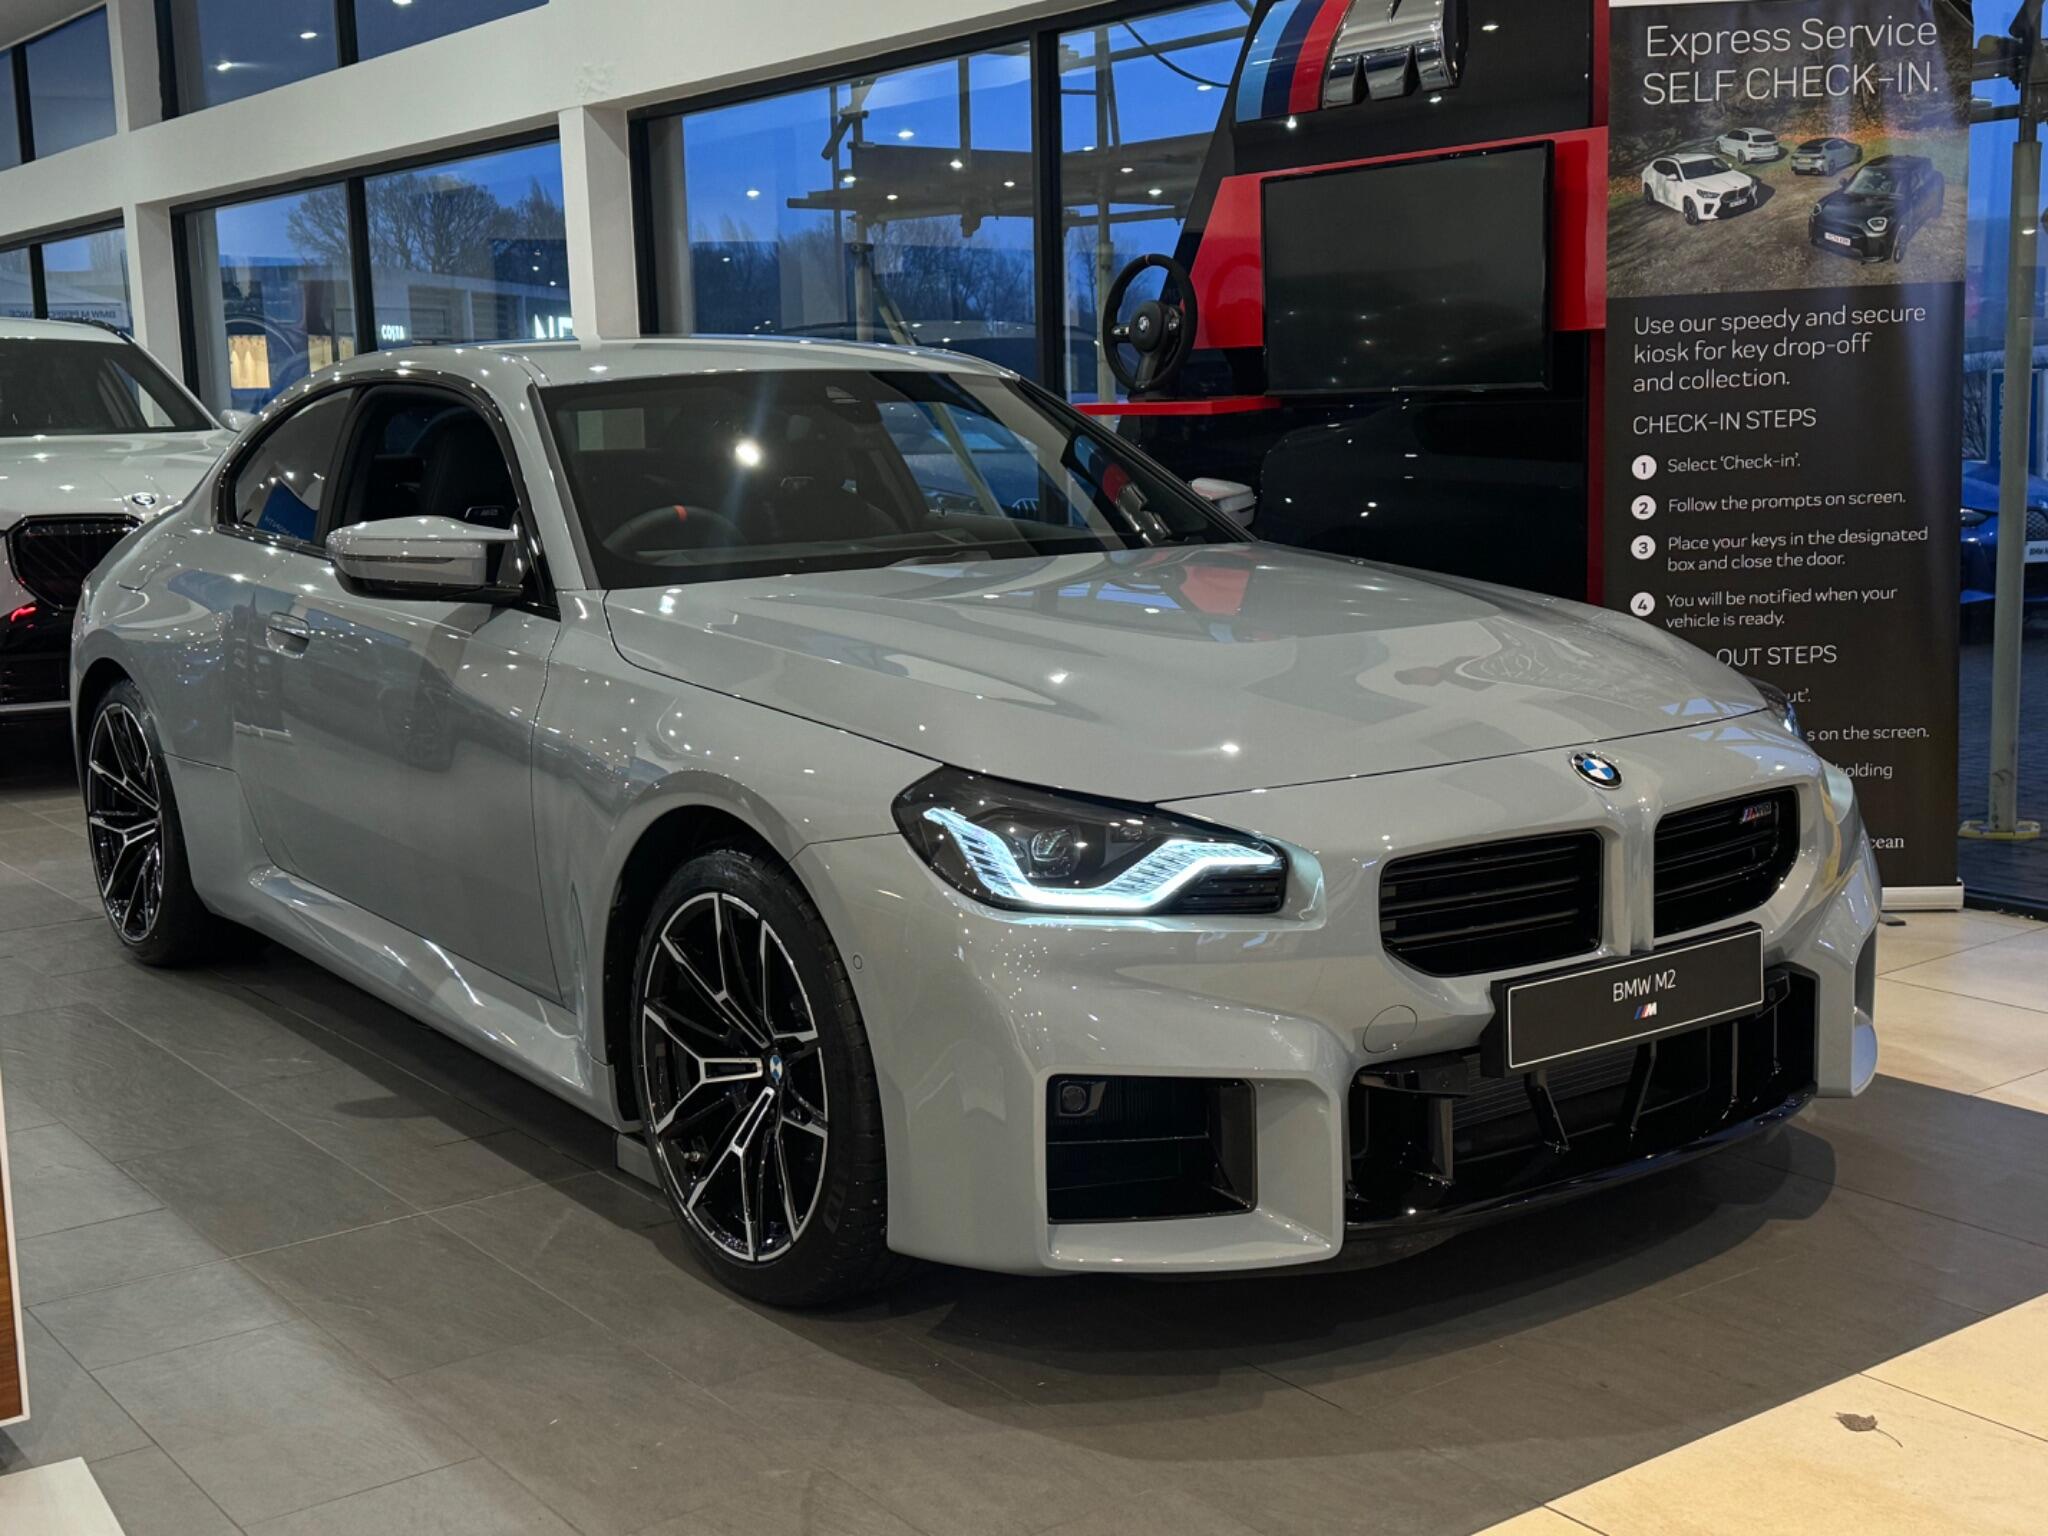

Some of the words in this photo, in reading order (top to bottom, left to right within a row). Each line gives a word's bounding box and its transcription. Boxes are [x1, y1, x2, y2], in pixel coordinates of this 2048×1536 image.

[1648, 26, 1790, 63] Express
[1801, 16, 1936, 50] Service
[1643, 68, 1737, 105] SELF
[1746, 61, 1938, 101] CHECK-IN.
[1634, 316, 1674, 336] Use
[1680, 318, 1716, 332] our
[1721, 310, 1800, 335] speedy
[1806, 305, 1846, 326] and
[1851, 305, 1926, 323] secure
[1634, 342, 1688, 363] kiosk
[1695, 340, 1726, 360] for
[1732, 339, 1768, 362] key
[1774, 333, 1872, 358] drop-off
[1634, 371, 1673, 392] and
[1679, 368, 1790, 390] collection.
[1633, 412, 1740, 434] CHECK-IN
[1746, 408, 1816, 429] STEPS
[1668, 458, 1717, 472] Select
[1669, 497, 1717, 512] Follow
[1721, 496, 1748, 510] the
[1752, 496, 1821, 511] prompts
[1825, 494, 1846, 507] on
[1849, 491, 1907, 505] screen.
[1668, 536, 1708, 550] Place
[1712, 537, 1747, 551] your
[1752, 533, 1786, 549] keys
[1791, 533, 1803, 545] in
[1808, 530, 1835, 544] the
[1838, 526, 1928, 545] designated
[1668, 557, 1695, 571] box
[1699, 555, 1727, 570] and
[1731, 554, 1772, 569] close
[1777, 552, 1803, 567] the
[1807, 551, 1845, 566] door.
[1667, 595, 1694, 607] You
[1698, 591, 1722, 606] will
[1726, 591, 1745, 605] be
[1749, 588, 1811, 604] notified
[1815, 587, 1857, 601] when
[1861, 589, 1897, 603] your
[1666, 613, 1720, 628] vehicle
[1724, 613, 1735, 626] is
[1739, 610, 1784, 626] ready.
[1768, 645, 1837, 665] STEPS
[1819, 731, 1838, 740] on
[1843, 726, 1869, 740] the
[1873, 728, 1929, 739] screen.
[1612, 974, 1652, 1002] BMW
[1655, 969, 1676, 992] M2
